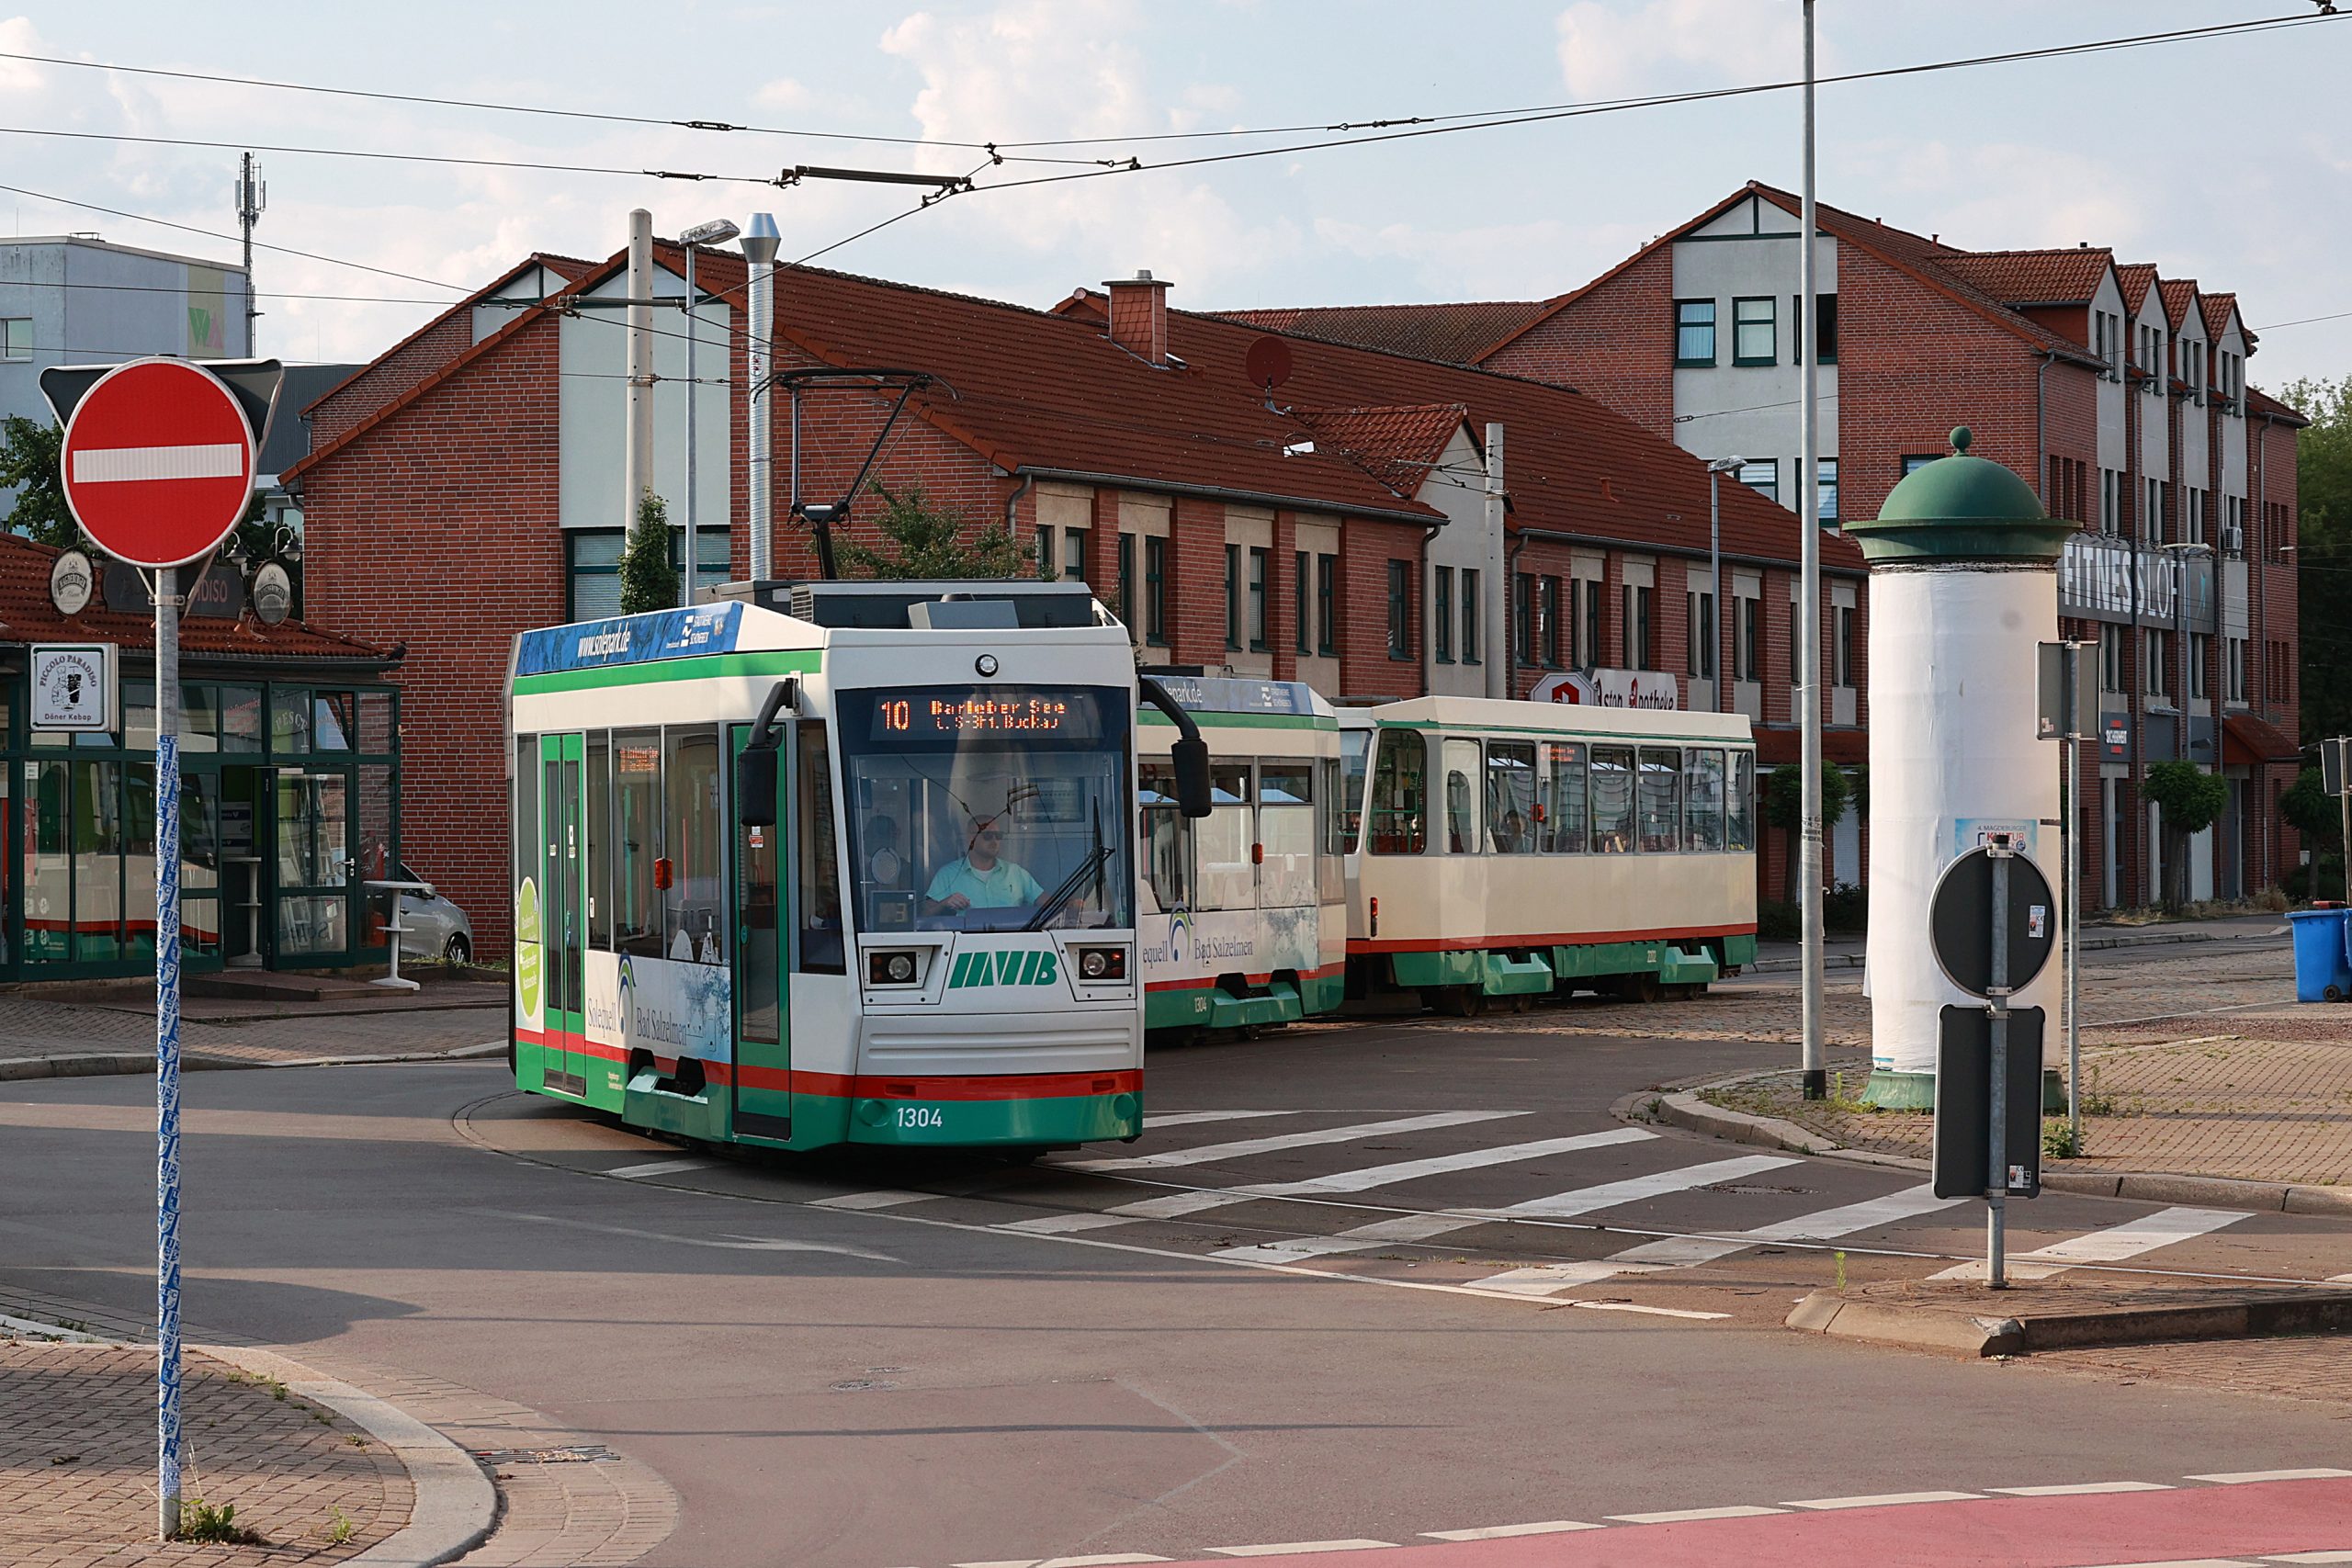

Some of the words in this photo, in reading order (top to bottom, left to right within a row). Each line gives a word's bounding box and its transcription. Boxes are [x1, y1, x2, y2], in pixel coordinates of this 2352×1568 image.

[577, 622, 631, 661] www.solepark.de
[40, 656, 65, 687] PICCOLO
[67, 655, 97, 687] PARADISO
[881, 701, 910, 730] 10
[931, 700, 1021, 716] Barleber
[1029, 699, 1066, 715] See
[1143, 941, 1169, 969] equell
[1194, 937, 1211, 960] Bad
[1213, 935, 1253, 957] Salzelmen
[588, 998, 616, 1038] Solequell
[637, 1007, 650, 1039] Bad
[651, 1010, 687, 1046] Salzelmen
[897, 1108, 943, 1127] 1304
